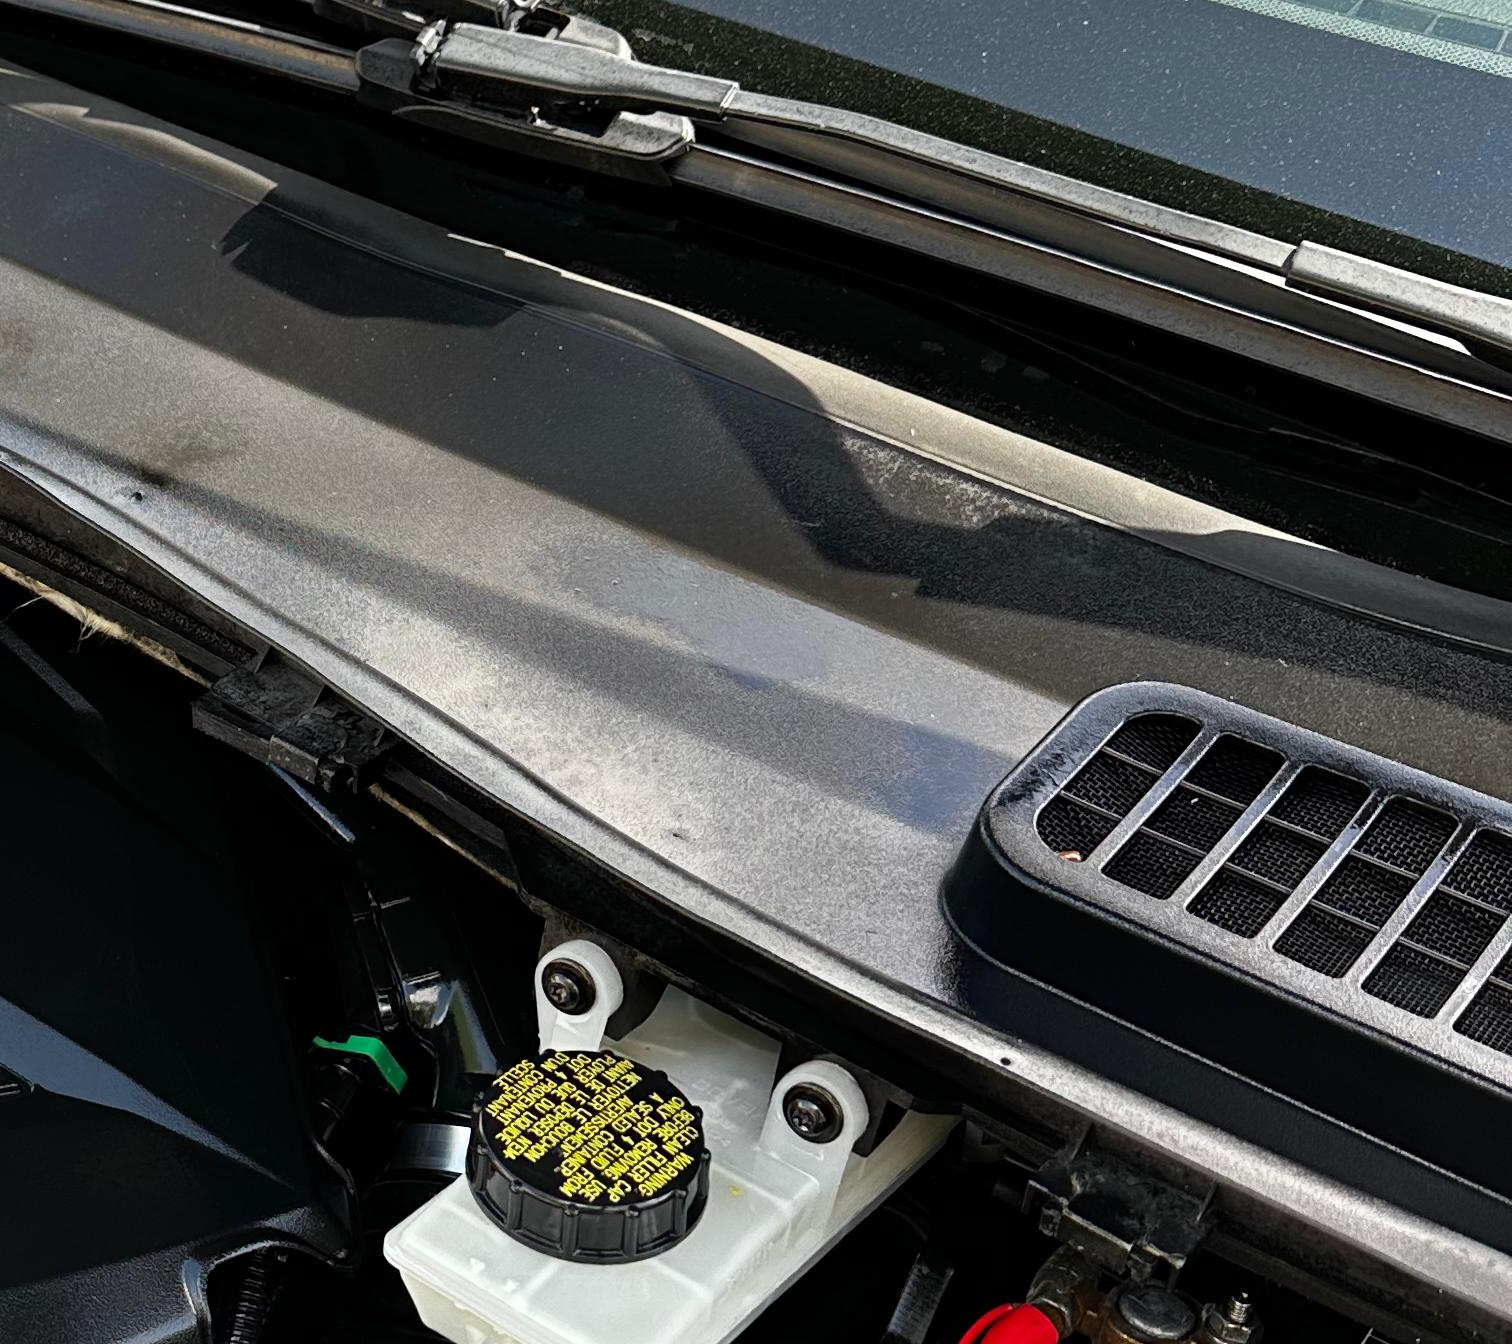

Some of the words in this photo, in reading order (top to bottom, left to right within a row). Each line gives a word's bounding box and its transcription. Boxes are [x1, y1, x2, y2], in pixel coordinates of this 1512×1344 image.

[554, 1070, 567, 1079] 4
[565, 1053, 591, 1072] DOT
[572, 1054, 616, 1086] PLOYER
[601, 1055, 634, 1082] AVANT
[484, 1069, 544, 1117] CONTENANT
[550, 1081, 576, 1100] QUE
[569, 1089, 590, 1105] LE
[584, 1078, 606, 1093] DE
[586, 1071, 642, 1110] NETTOYER
[648, 1091, 664, 1103] A
[496, 1077, 557, 1126] PROVENANT
[534, 1097, 555, 1114] DU
[655, 1096, 684, 1120] ONLY
[494, 1110, 538, 1145] LIQUIDE
[568, 1107, 592, 1124] LE
[611, 1100, 653, 1132] SEALED
[632, 1115, 659, 1137] DOT
[651, 1109, 695, 1141] BEFORE
[522, 1120, 575, 1162] BOUCHON
[620, 1134, 634, 1145] 4
[661, 1125, 698, 1155] CLEAN
[590, 1142, 624, 1170] FLUID
[626, 1150, 667, 1182] FILLER
[558, 1166, 594, 1197] FROM
[578, 1179, 607, 1202] USE
[606, 1179, 631, 1202] CAP
